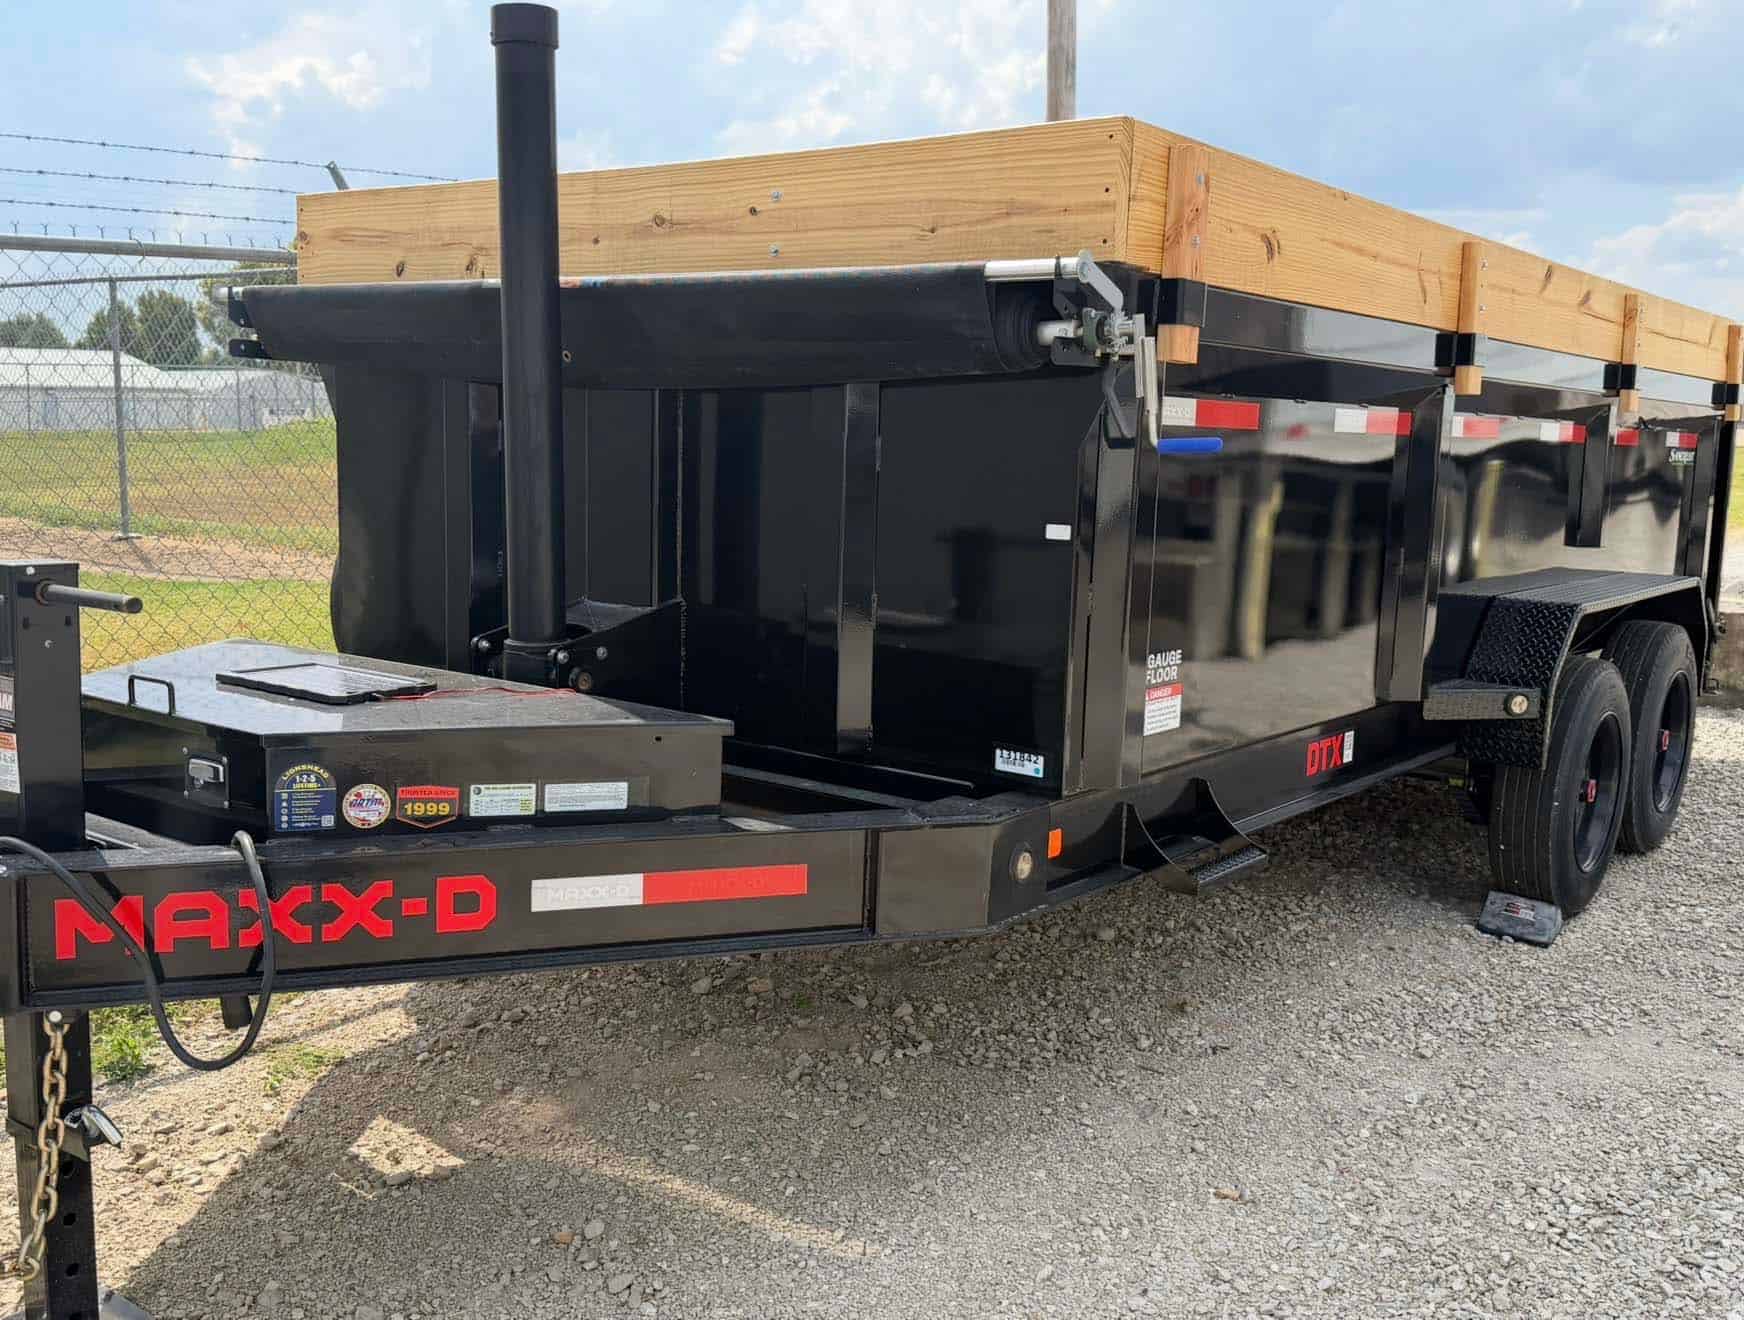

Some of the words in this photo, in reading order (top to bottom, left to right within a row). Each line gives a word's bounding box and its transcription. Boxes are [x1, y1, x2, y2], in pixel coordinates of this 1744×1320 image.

[1147, 649, 1183, 669] GAUGE
[1146, 666, 1178, 684] FLOOR
[1306, 733, 1344, 777] DTX
[281, 763, 330, 781] LIONSHEAD
[296, 774, 317, 783] 1-2-5
[404, 802, 451, 816] 1999
[55, 874, 497, 960] MAXX-D
